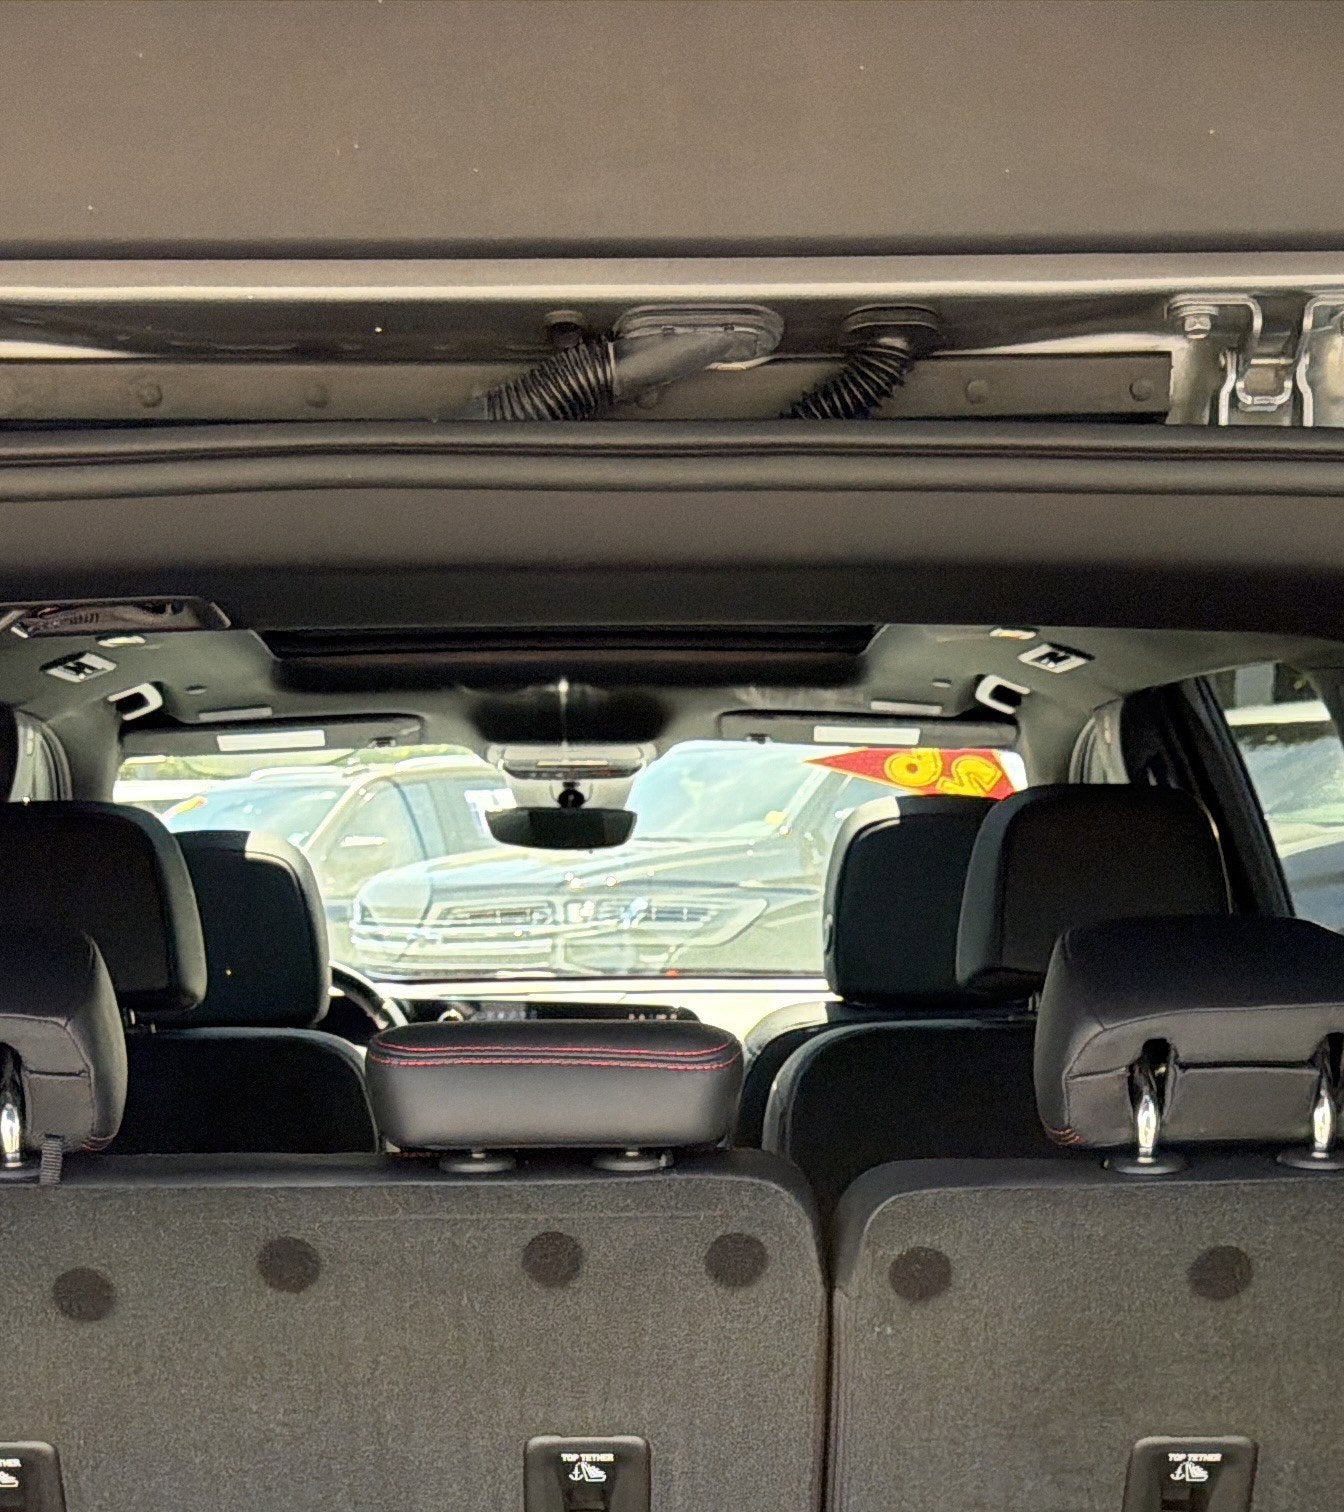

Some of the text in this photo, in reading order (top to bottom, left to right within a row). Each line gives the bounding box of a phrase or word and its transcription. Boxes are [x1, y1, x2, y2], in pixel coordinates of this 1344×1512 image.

[561, 1453, 614, 1462] TOP TETHER
[1168, 1453, 1222, 1462] TOP TETHER
